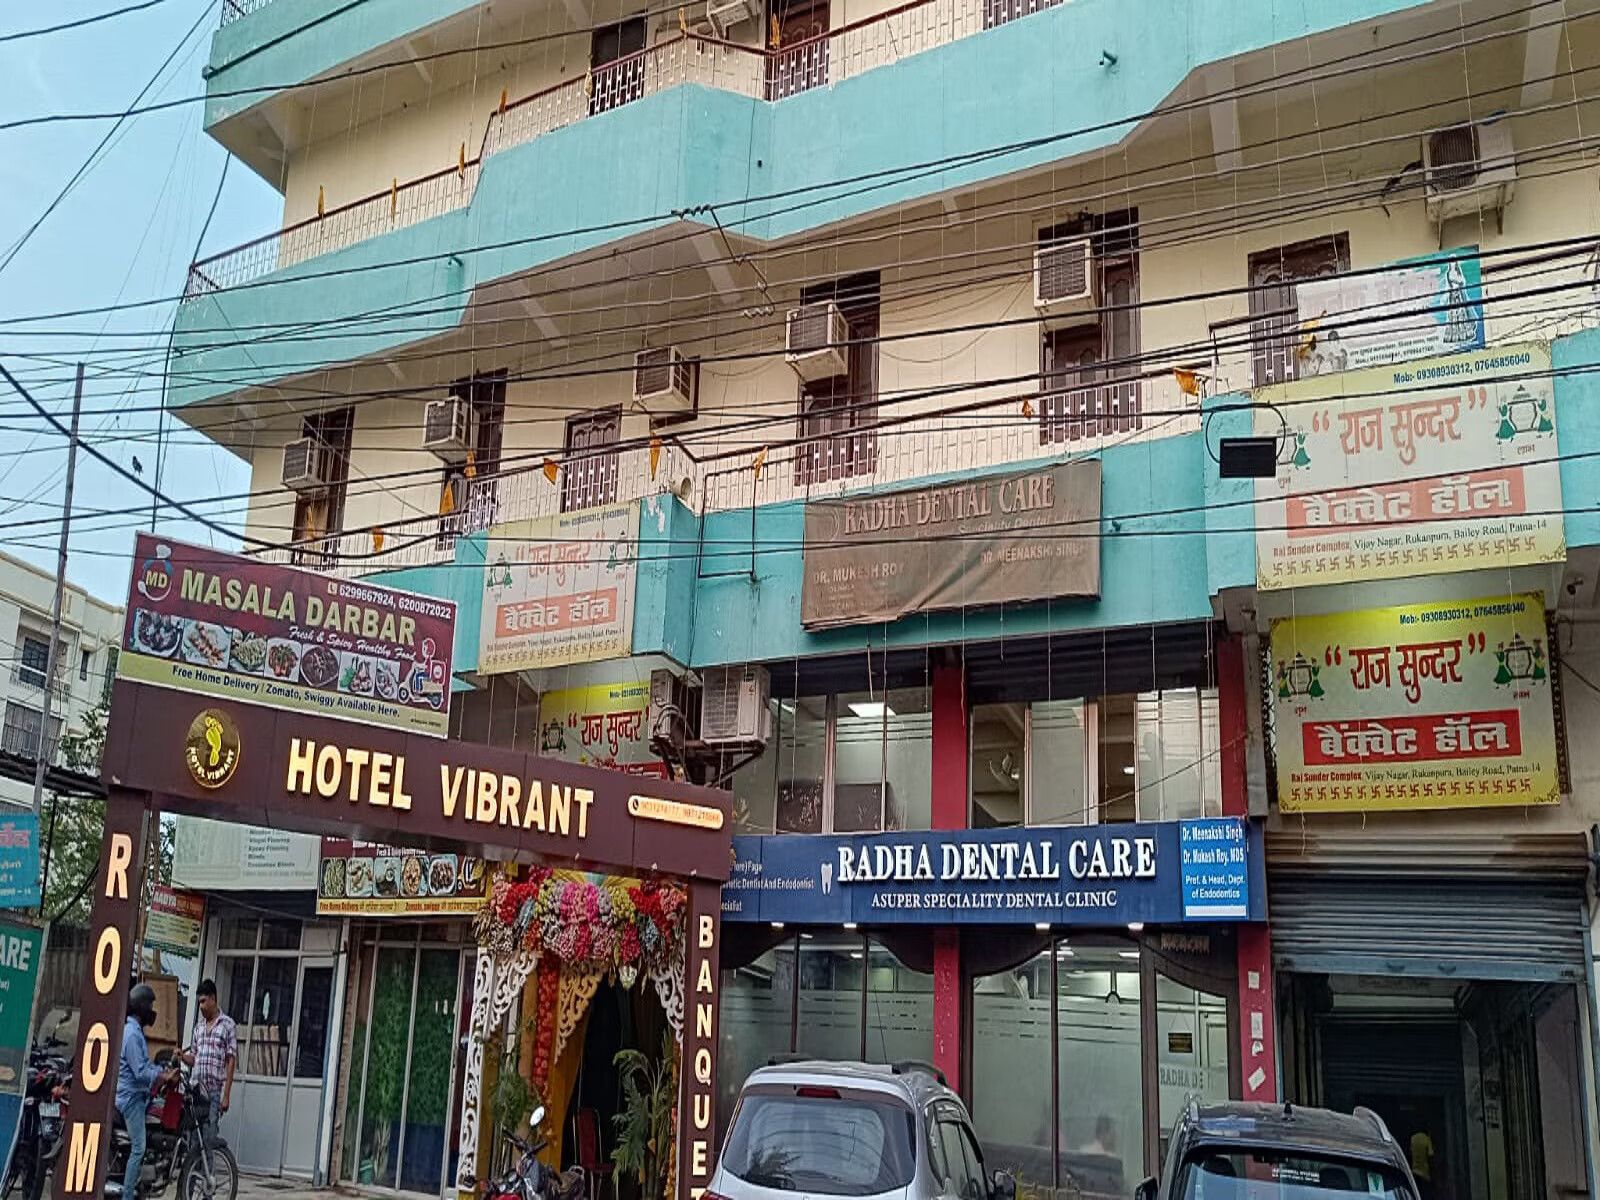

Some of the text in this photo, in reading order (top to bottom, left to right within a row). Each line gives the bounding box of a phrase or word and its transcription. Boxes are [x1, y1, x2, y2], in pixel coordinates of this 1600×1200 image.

[844, 473, 1055, 535] RADHA DENTAL CARE
[1354, 539, 1376, 550] Vijay
[145, 570, 168, 588] MD
[180, 569, 417, 647] MASALA DARBAR
[339, 584, 451, 619] 6299667924, 6200872022
[172, 665, 193, 679] Free
[195, 669, 221, 683] Home
[223, 676, 259, 693] Delivery
[266, 683, 302, 701] Zomato,
[304, 691, 335, 707] Swiggy
[337, 696, 377, 713] Available
[378, 706, 401, 718] Here.
[1433, 716, 1510, 753] हॉल
[286, 738, 594, 839] HOTEL VIBRANT
[1225, 823, 1243, 842] Singh
[837, 838, 1157, 882] RADHA DENTAL CARE
[1191, 889, 1199, 898] of
[1201, 875, 1208, 885] &
[923, 892, 1003, 908] SPECIALITY
[1006, 892, 1063, 908] DENTAL
[1064, 890, 1117, 907] CLINIC
